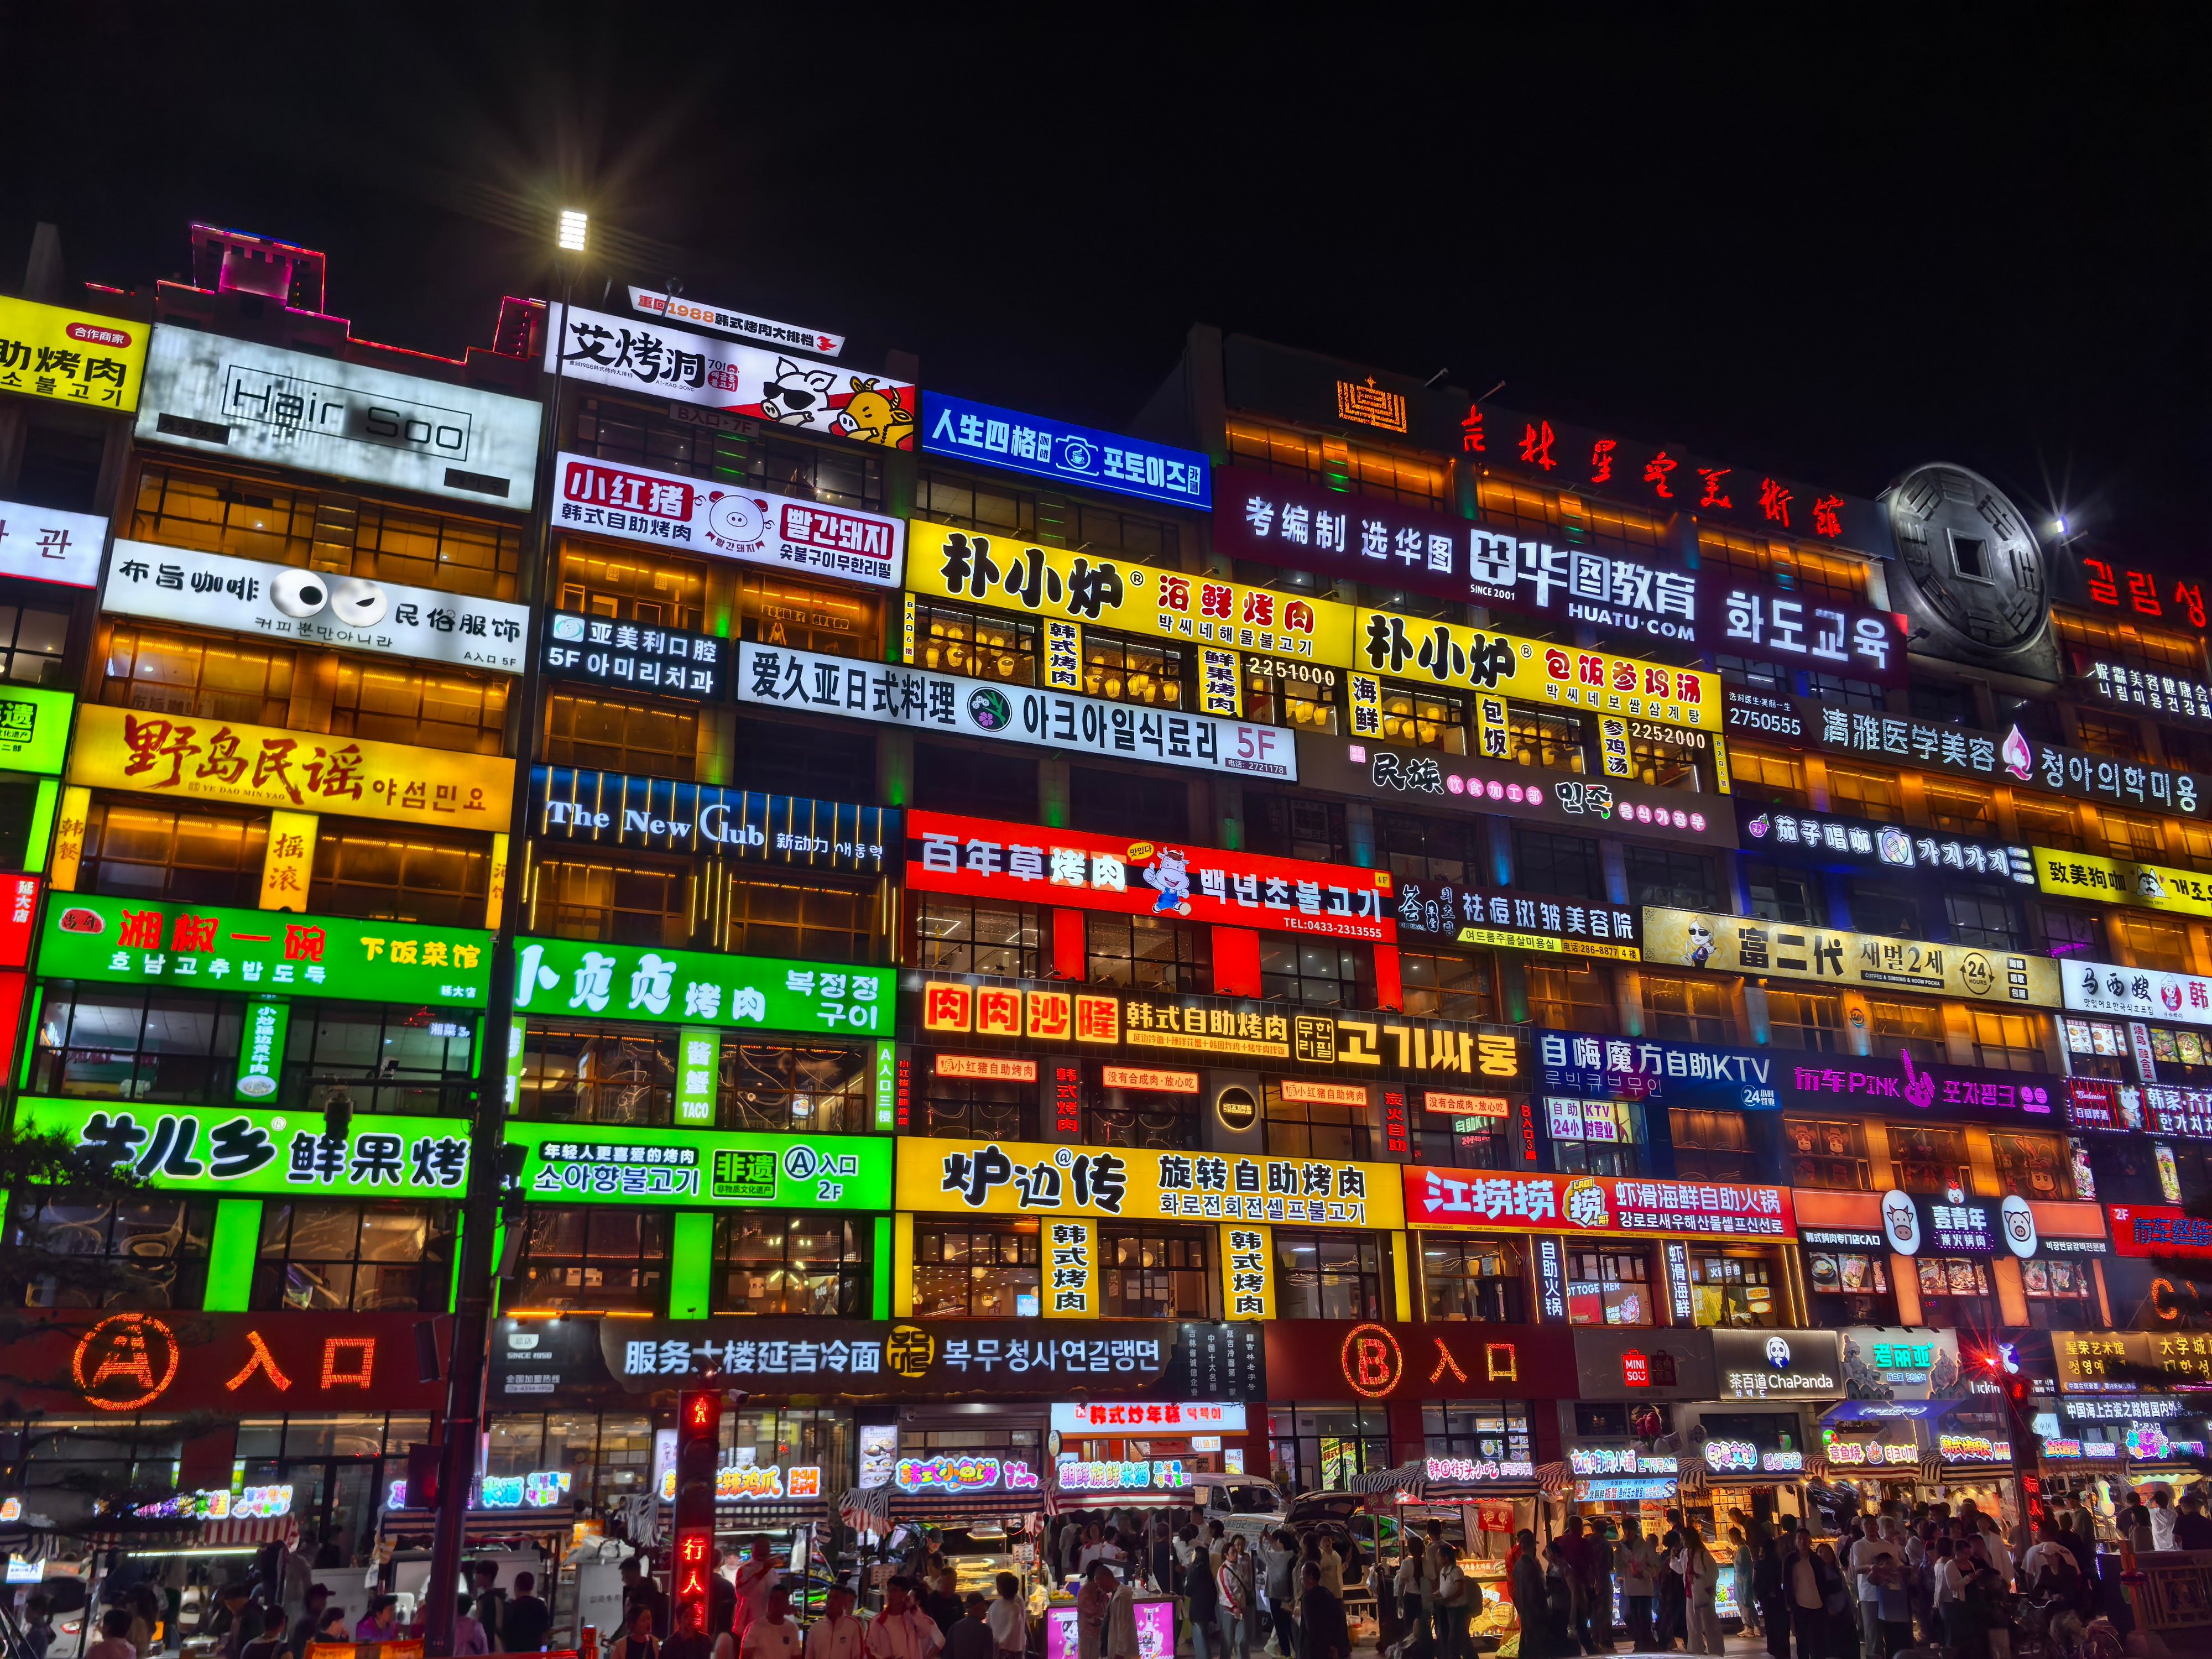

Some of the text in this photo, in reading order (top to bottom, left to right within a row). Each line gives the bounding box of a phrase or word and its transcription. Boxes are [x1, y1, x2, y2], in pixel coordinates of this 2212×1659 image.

[75, 326, 124, 345] 合作商家
[637, 294, 814, 348] 重回1988韩式烤肉大排档
[556, 322, 706, 389] 艾烤洞
[656, 380, 695, 392] AI-KAO-DONG
[233, 378, 466, 450] Hair Soo
[732, 419, 753, 434] 7F
[932, 409, 1036, 460] 人生四格
[1039, 434, 1051, 462] 咖啡
[1103, 446, 1187, 492] 포토이즈
[1188, 467, 1199, 494] 카페
[570, 468, 684, 518] 小红猪
[562, 502, 691, 541] 韩式自助烤肉
[786, 508, 889, 555] 빨간돼지
[1245, 496, 1453, 574] 考编制 选华图
[716, 537, 755, 552] 빨간돼지
[780, 544, 891, 579] 숯불구이무한리필
[119, 559, 259, 601] 布旨咖啡
[939, 532, 1124, 619] 朴小炉
[1470, 584, 1515, 600] SINCE 2001
[1517, 542, 1695, 620] 华图教育
[2084, 557, 2206, 628] 길림성
[396, 603, 520, 643] 民俗服饰
[1157, 573, 1315, 635] 海鲜烤肉
[255, 617, 392, 648] 커피뿐만아니라
[588, 621, 717, 663] 亚美利口腔
[1159, 614, 1313, 657] 박씨네해물불고기
[1726, 590, 1889, 670] 화도교육
[464, 651, 517, 666] A入口 5F
[549, 647, 714, 693] 5F 아미리치과
[1049, 622, 1078, 686] 韩式烤肉
[1364, 614, 1516, 690] 朴小炉
[752, 651, 956, 725] 爱久亚日式料理
[1204, 650, 1237, 713] 鲜果烤肉
[1249, 657, 1334, 686] 2251000
[1545, 648, 1702, 705] 包饭参鸡汤
[1352, 676, 1381, 735] 海鲜
[1546, 684, 1700, 724] 박씨네보쌈삼계탕
[1730, 708, 1801, 735] 2750555
[1023, 694, 1218, 765] 아크아일식료리
[1237, 727, 1276, 760] 5F
[1481, 698, 1507, 755] 包饭
[1632, 722, 1705, 749] 2252000
[1822, 707, 1995, 771] 清雅医学美容
[124, 713, 365, 806] 野岛民谣
[1603, 719, 1629, 775] 参鸡汤
[1249, 761, 1284, 774] 2721178
[1372, 752, 1444, 795] 民族
[1448, 776, 1541, 804] 饮食加工部
[2041, 748, 2197, 812] 청아의학미용
[373, 778, 486, 813] 야섬민요
[1556, 781, 1613, 818] 민족
[58, 817, 84, 861] 韩餐
[547, 800, 828, 853] The New Club 新动力
[1774, 815, 1872, 853] 茄子唱咖
[269, 832, 304, 892] 摇滚
[922, 833, 1126, 891] 百年草烤肉
[1129, 844, 1152, 857] 맛있다
[1917, 838, 2010, 876] 가지가지
[1377, 875, 1389, 885] 4F
[2048, 860, 2127, 891] 致美狗咖
[13, 881, 34, 923] 延大店
[1200, 869, 1382, 923] 백년초불고기
[1284, 917, 1382, 938] TEL:0433-2313555
[1399, 922, 1426, 931] HERBAL
[1463, 893, 1634, 939] 祛痘斑皱美容院
[117, 909, 326, 962] 湘椒一碗
[360, 937, 481, 968] 下饭菜馆
[1466, 930, 1554, 950] 여드름주름살미용실
[1739, 927, 1844, 977] 富二代
[108, 951, 326, 984] 호남고추밥도둑
[1860, 942, 1944, 975] 재벌2세
[1968, 961, 1986, 978] 24
[440, 985, 477, 998] 延大店
[515, 944, 766, 1022] 卜贞贞烤肉
[786, 969, 879, 1000] 복정정
[817, 1002, 878, 1029] 구이
[928, 987, 1118, 1039] 肉肉沙隆
[1126, 1001, 1287, 1041] 韩式自助烤肉
[1298, 1022, 1331, 1039] 무한
[1299, 1041, 1332, 1058] 리필
[1338, 1020, 1517, 1076] 고기싸롱
[1540, 1035, 1770, 1083] 自嗨魔方自助KTV
[686, 1041, 711, 1094] 酱蟹
[1545, 1070, 1663, 1098] 루빅큐브무인
[682, 1102, 709, 1119] TACO
[1055, 1067, 1079, 1133] 韩式烤肉
[1553, 1102, 1610, 1118] 自助 KTV
[1743, 1089, 1760, 1104] 24
[1942, 1080, 2016, 1107] 포차핑크
[2076, 1091, 2106, 1100] Budweiser
[1384, 1092, 1407, 1152] 炭火自助
[286, 1130, 470, 1188] 鲜果烤
[544, 1144, 694, 1164] 年轻人更喜爱的烤肉
[717, 1154, 774, 1182] 非遗
[533, 1164, 700, 1195] 소아향불고기
[717, 1184, 771, 1196] 非物质文化遗产
[817, 1181, 843, 1201] 2F
[1160, 1155, 1366, 1198] 旋转自助烤肉
[1423, 1171, 1556, 1219] 江捞捞
[1160, 1193, 1366, 1224] 화로전회전셀프불고기
[1615, 1181, 1782, 1213] 虾滑海鲜自助火锅
[2114, 1209, 2128, 1220] 2F
[1932, 1206, 1986, 1230] 壹青年
[1806, 1232, 1880, 1246] 韩式烤肉专门店C入口
[1940, 1234, 1986, 1248] 炭火烤肉
[1052, 1224, 1089, 1312] 韩式烤肉
[1229, 1231, 1265, 1314] 韩式烤肉
[1541, 1241, 1562, 1316] 自助火锅
[1668, 1245, 1690, 1317] 虾滑海鲜
[225, 1331, 375, 1391] 入口
[942, 1339, 1160, 1373] 복무청사연길랭면
[1207, 1334, 1217, 1391] 中国十大名面
[1227, 1330, 1237, 1396] 延吉冷面第一家
[1430, 1338, 1517, 1384] 入口
[1626, 1359, 1645, 1370] MINI
[1874, 1343, 1931, 1368] 考丽亚
[1729, 1373, 1833, 1390] 茶百道 ChaPanda
[1735, 1389, 1766, 1399] 차백도
[1090, 1405, 1181, 1426] 韩式炒年糕
[1427, 1459, 1499, 1480] 韩国街头小吃
[1571, 1449, 1635, 1474] 玄氏明洞小铺
[1707, 1442, 1757, 1469] 印象文创
[1829, 1444, 1864, 1464] 章鱼烧
[898, 1458, 998, 1491] 韩式小鱼饼
[1060, 1461, 1150, 1488] 朝鲜族鲜米酒
